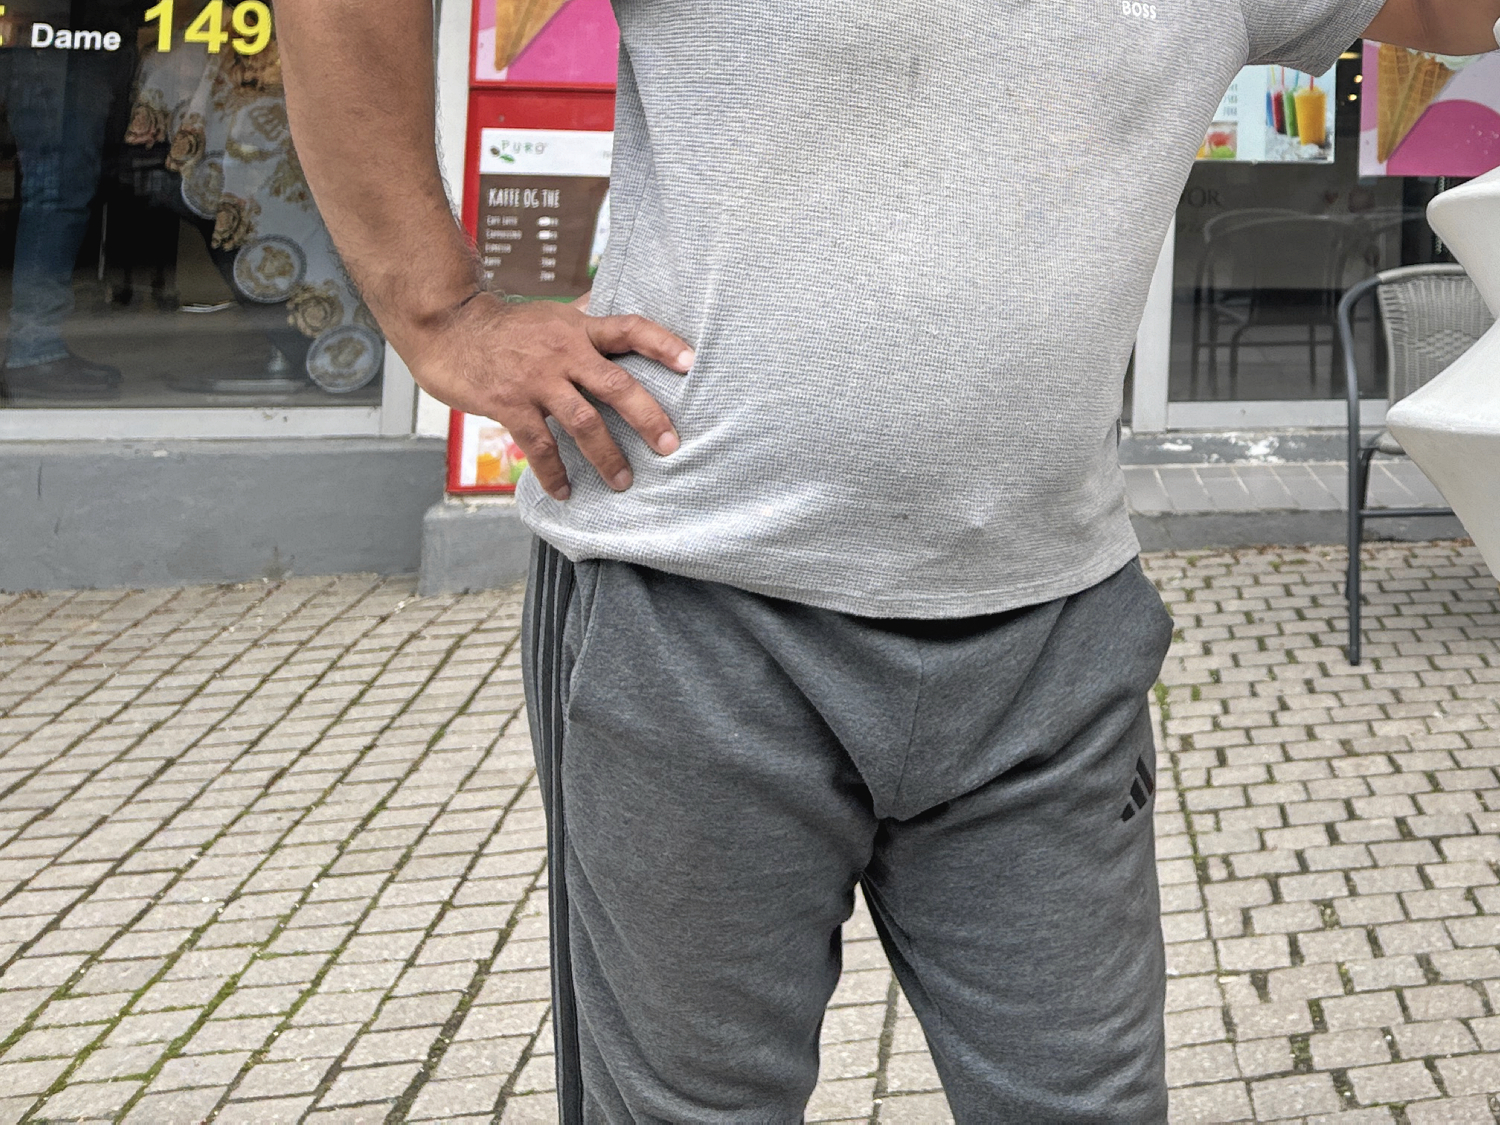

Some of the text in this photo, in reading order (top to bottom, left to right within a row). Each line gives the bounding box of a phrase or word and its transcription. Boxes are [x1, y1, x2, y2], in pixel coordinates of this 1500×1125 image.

[1122, 0, 1157, 20] BOSS
[30, 22, 122, 51] Dame
[501, 139, 546, 155] PURO
[488, 188, 561, 208] KAFFE OG THE
